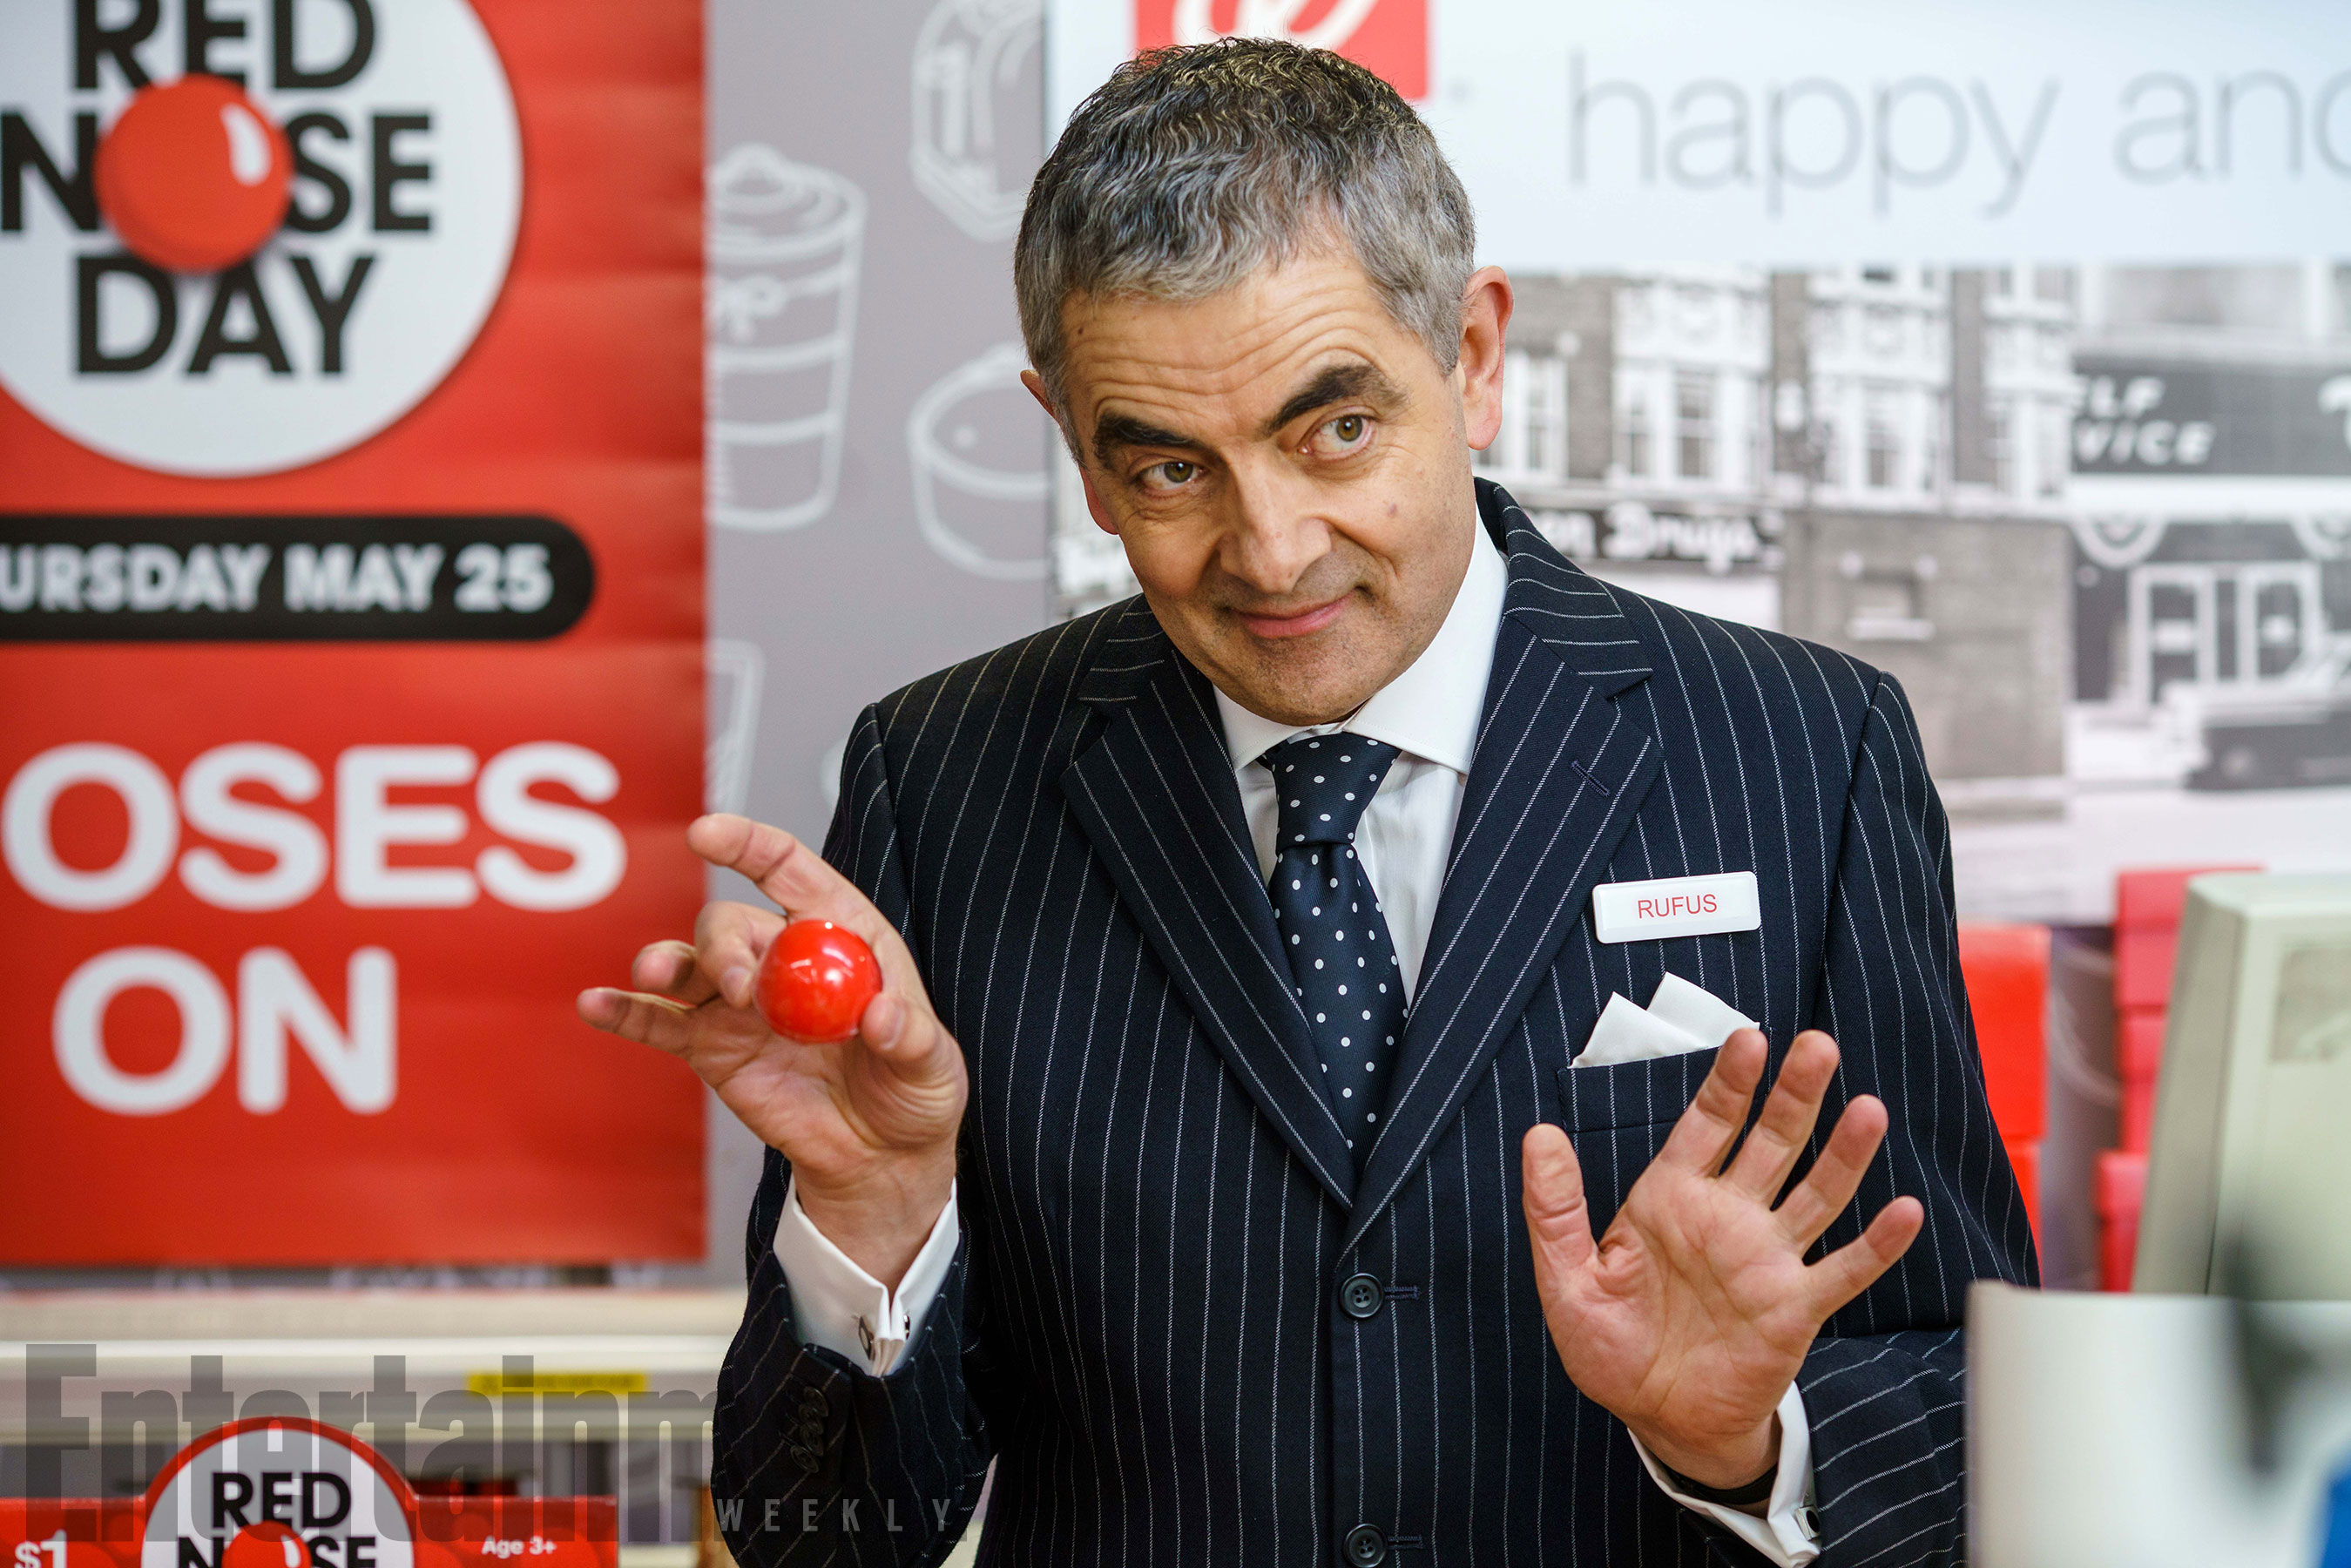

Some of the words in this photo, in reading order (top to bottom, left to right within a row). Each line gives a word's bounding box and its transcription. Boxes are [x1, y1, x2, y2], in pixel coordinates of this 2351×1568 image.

[74, 0, 376, 91] RED
[0, 110, 434, 233] NSE
[1570, 47, 2061, 220] happy
[73, 253, 380, 378] DAY
[283, 543, 445, 612] MAY
[454, 542, 554, 612] 25
[3, 741, 626, 912] OSES
[1638, 894, 1718, 919] RUFUS
[52, 946, 398, 1116] ON
[212, 1472, 352, 1529] RED
[177, 1536, 376, 1568] NSE
[481, 1536, 524, 1559] Age
[529, 1536, 557, 1555] 3+
